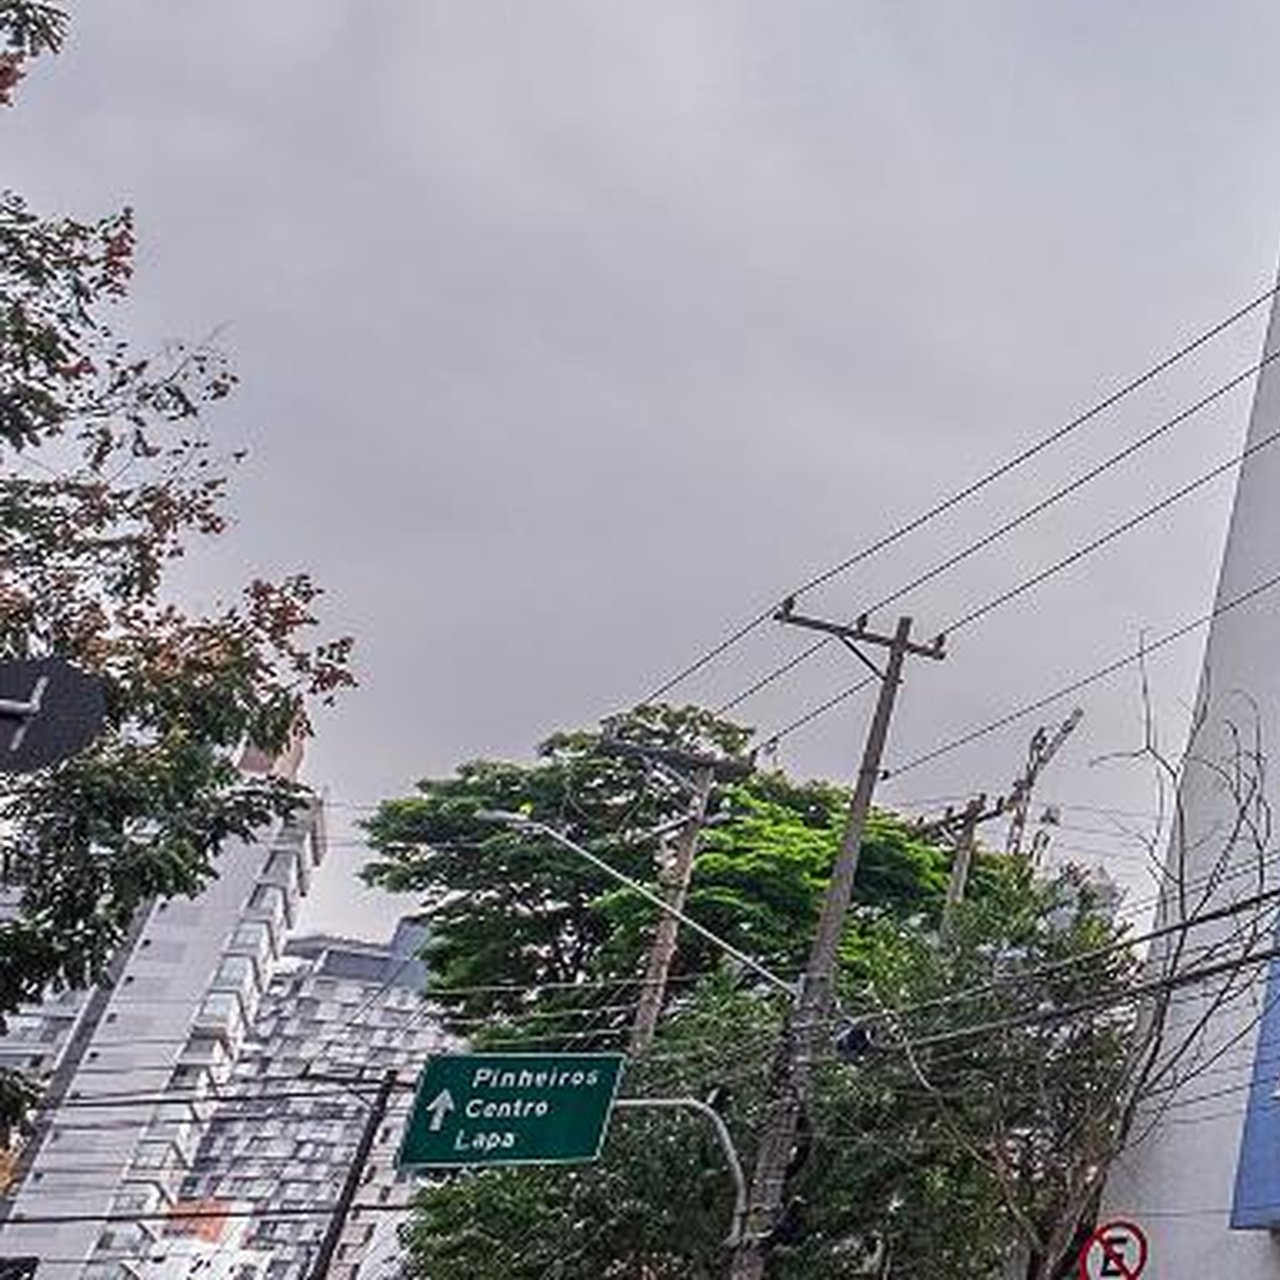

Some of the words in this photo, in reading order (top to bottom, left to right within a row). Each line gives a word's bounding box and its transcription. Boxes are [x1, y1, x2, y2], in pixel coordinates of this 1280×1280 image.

[472, 1067, 599, 1088] Pinheiros
[465, 1099, 549, 1118] Centro
[454, 1129, 515, 1153] Lapa
[1101, 1237, 1128, 1277] E
